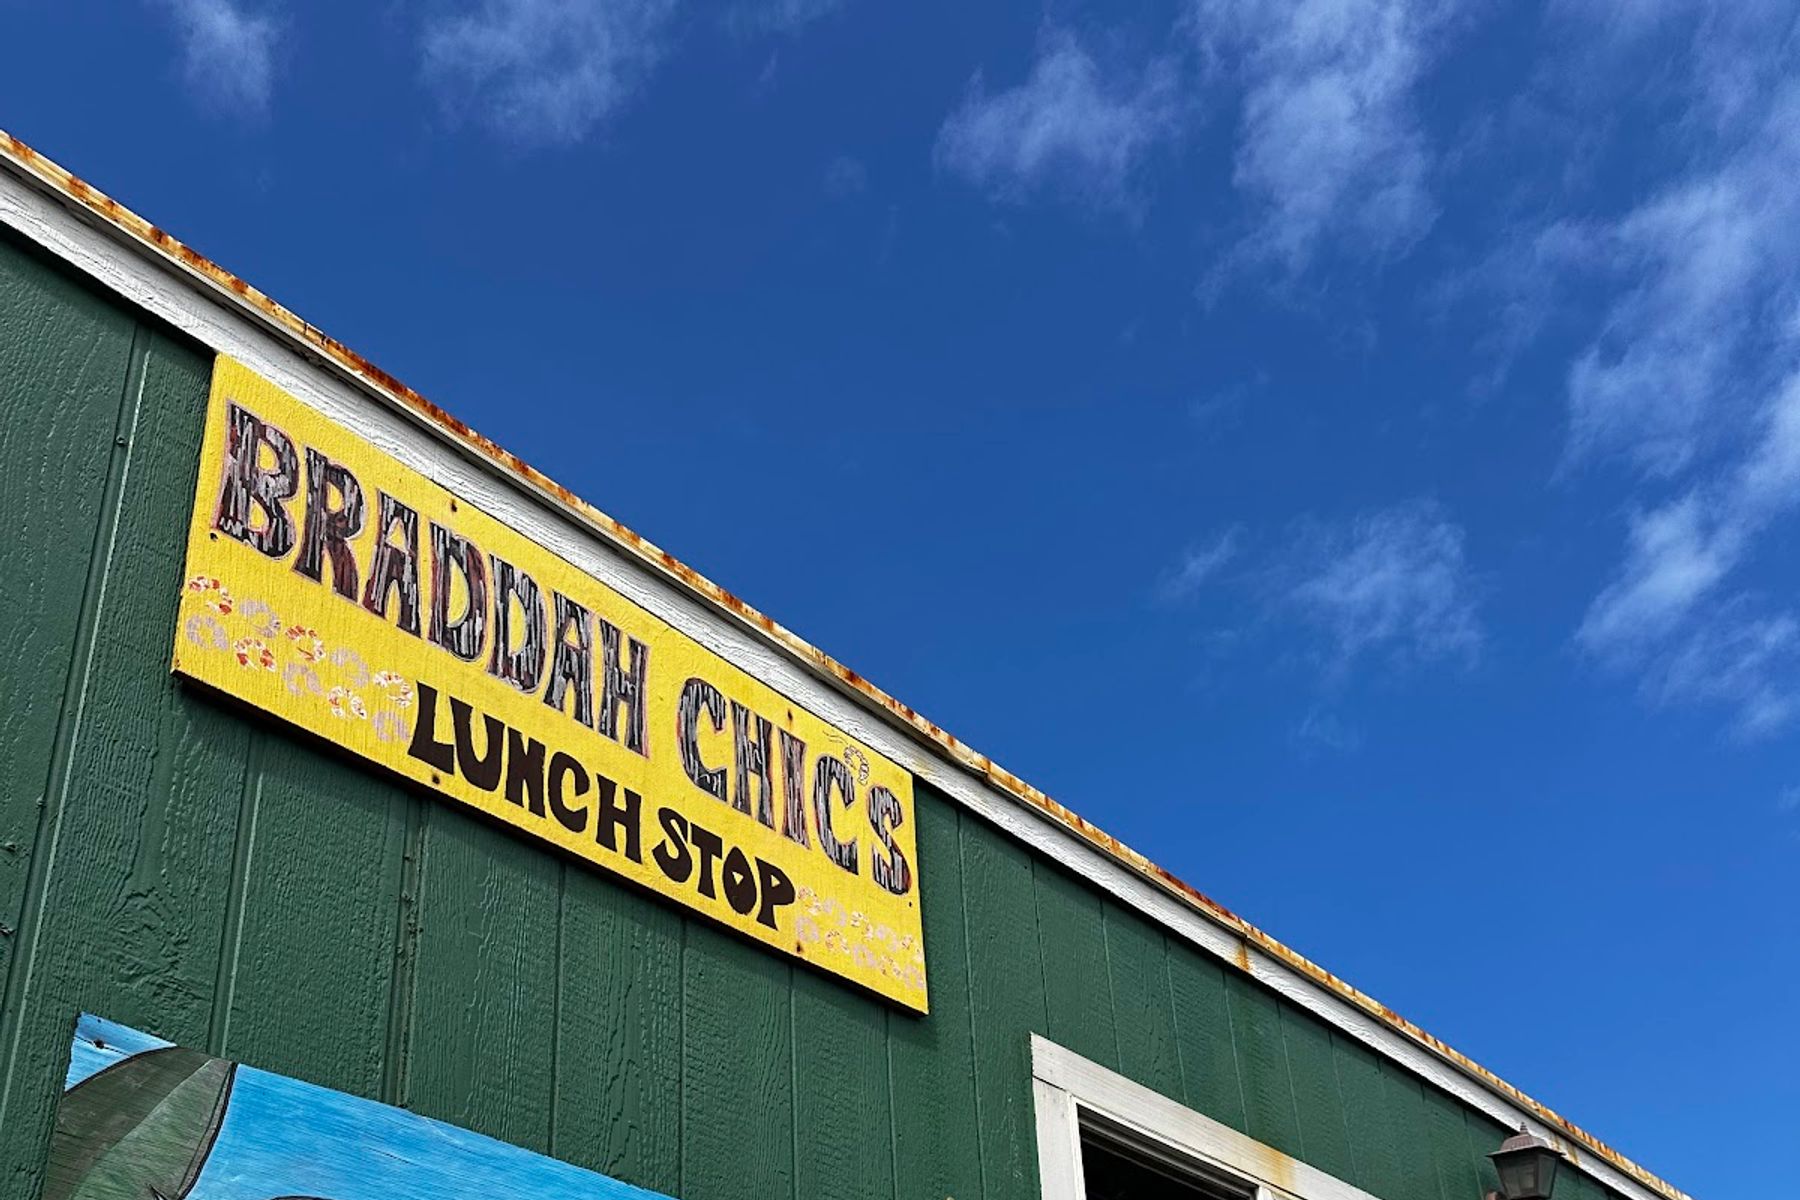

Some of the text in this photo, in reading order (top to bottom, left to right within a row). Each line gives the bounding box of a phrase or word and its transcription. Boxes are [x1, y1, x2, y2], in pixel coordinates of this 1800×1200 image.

[216, 397, 652, 757] BRADDAH
[408, 681, 798, 931] LUNCH STOP
